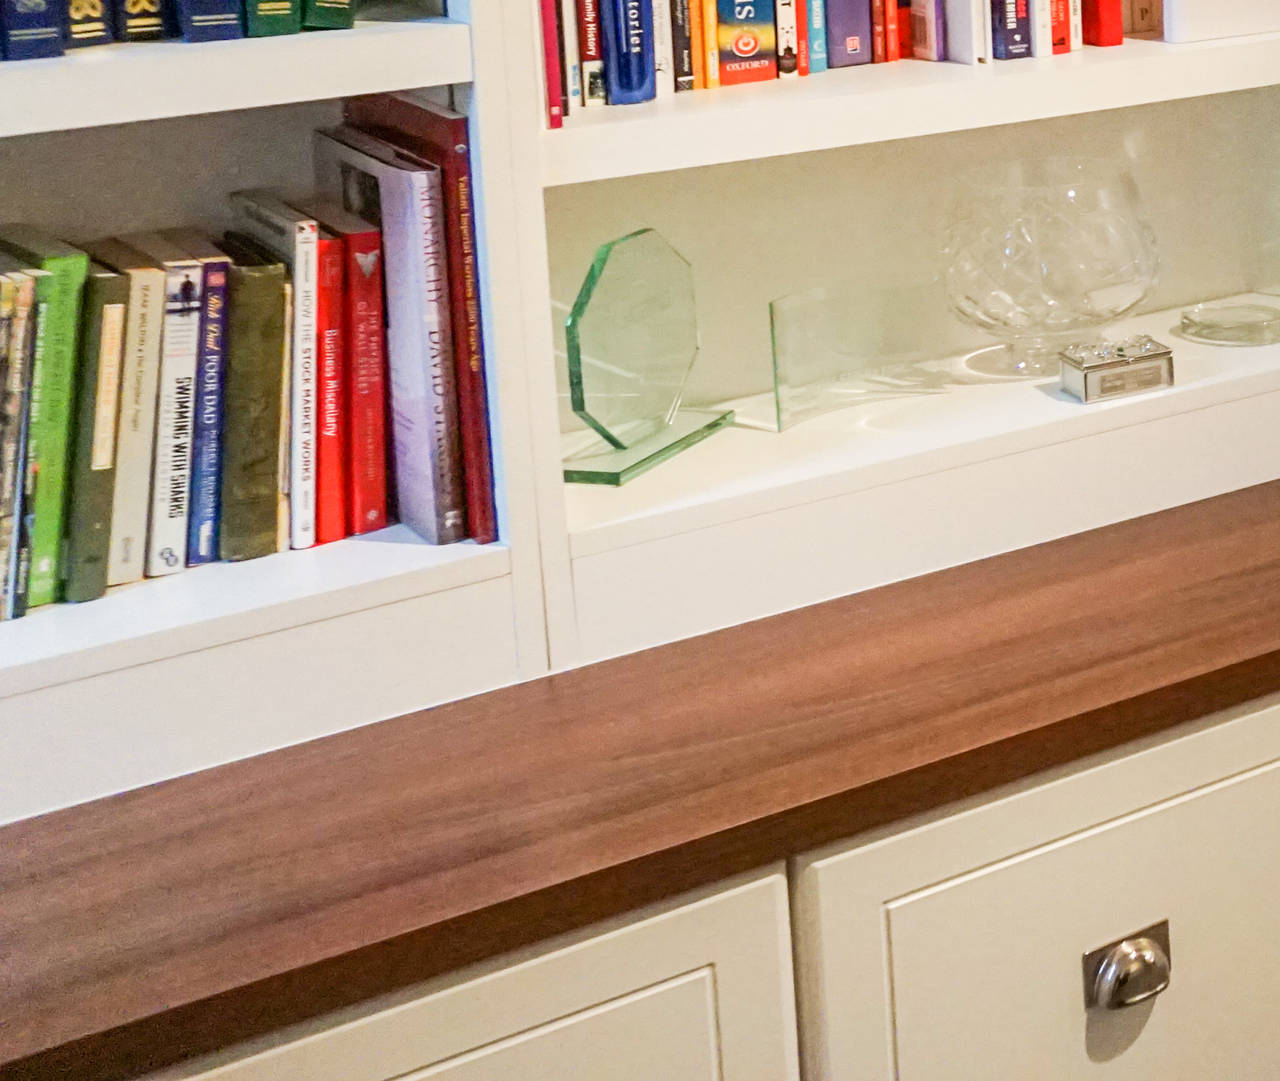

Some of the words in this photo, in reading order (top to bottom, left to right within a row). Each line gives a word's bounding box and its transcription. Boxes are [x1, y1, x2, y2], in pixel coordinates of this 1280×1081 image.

[584, 23, 598, 57] History
[457, 175, 470, 209] Valiant
[417, 182, 442, 305] MONARCHY
[459, 212, 472, 253] Imperial
[204, 355, 217, 391] POOR
[301, 347, 312, 384] STOCK
[323, 329, 338, 379] Business
[428, 330, 449, 398] DAVID
[172, 376, 192, 439] SWIMMING
[203, 395, 217, 424] DAD
[301, 389, 313, 435] MARKET
[321, 380, 338, 436] Miscellany
[172, 442, 191, 471] WITH
[302, 439, 313, 482] WORKS
[168, 474, 189, 518] SHARKS
